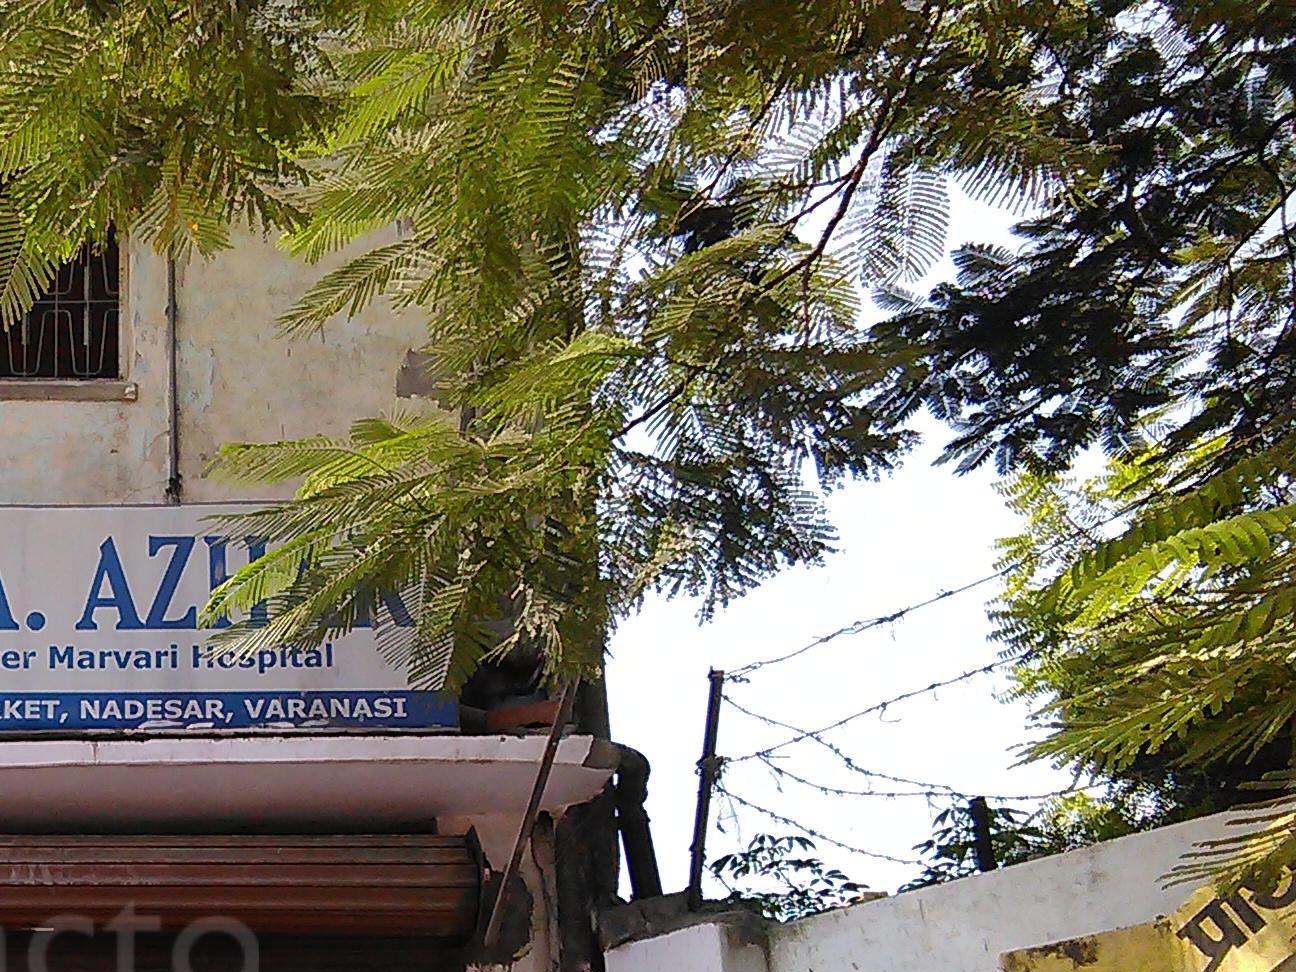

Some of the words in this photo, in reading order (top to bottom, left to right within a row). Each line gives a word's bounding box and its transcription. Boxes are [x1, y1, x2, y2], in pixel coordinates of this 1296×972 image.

[48, 644, 179, 670] Marvari
[80, 699, 234, 724] NADESAR,
[244, 697, 408, 719] VARANASI
